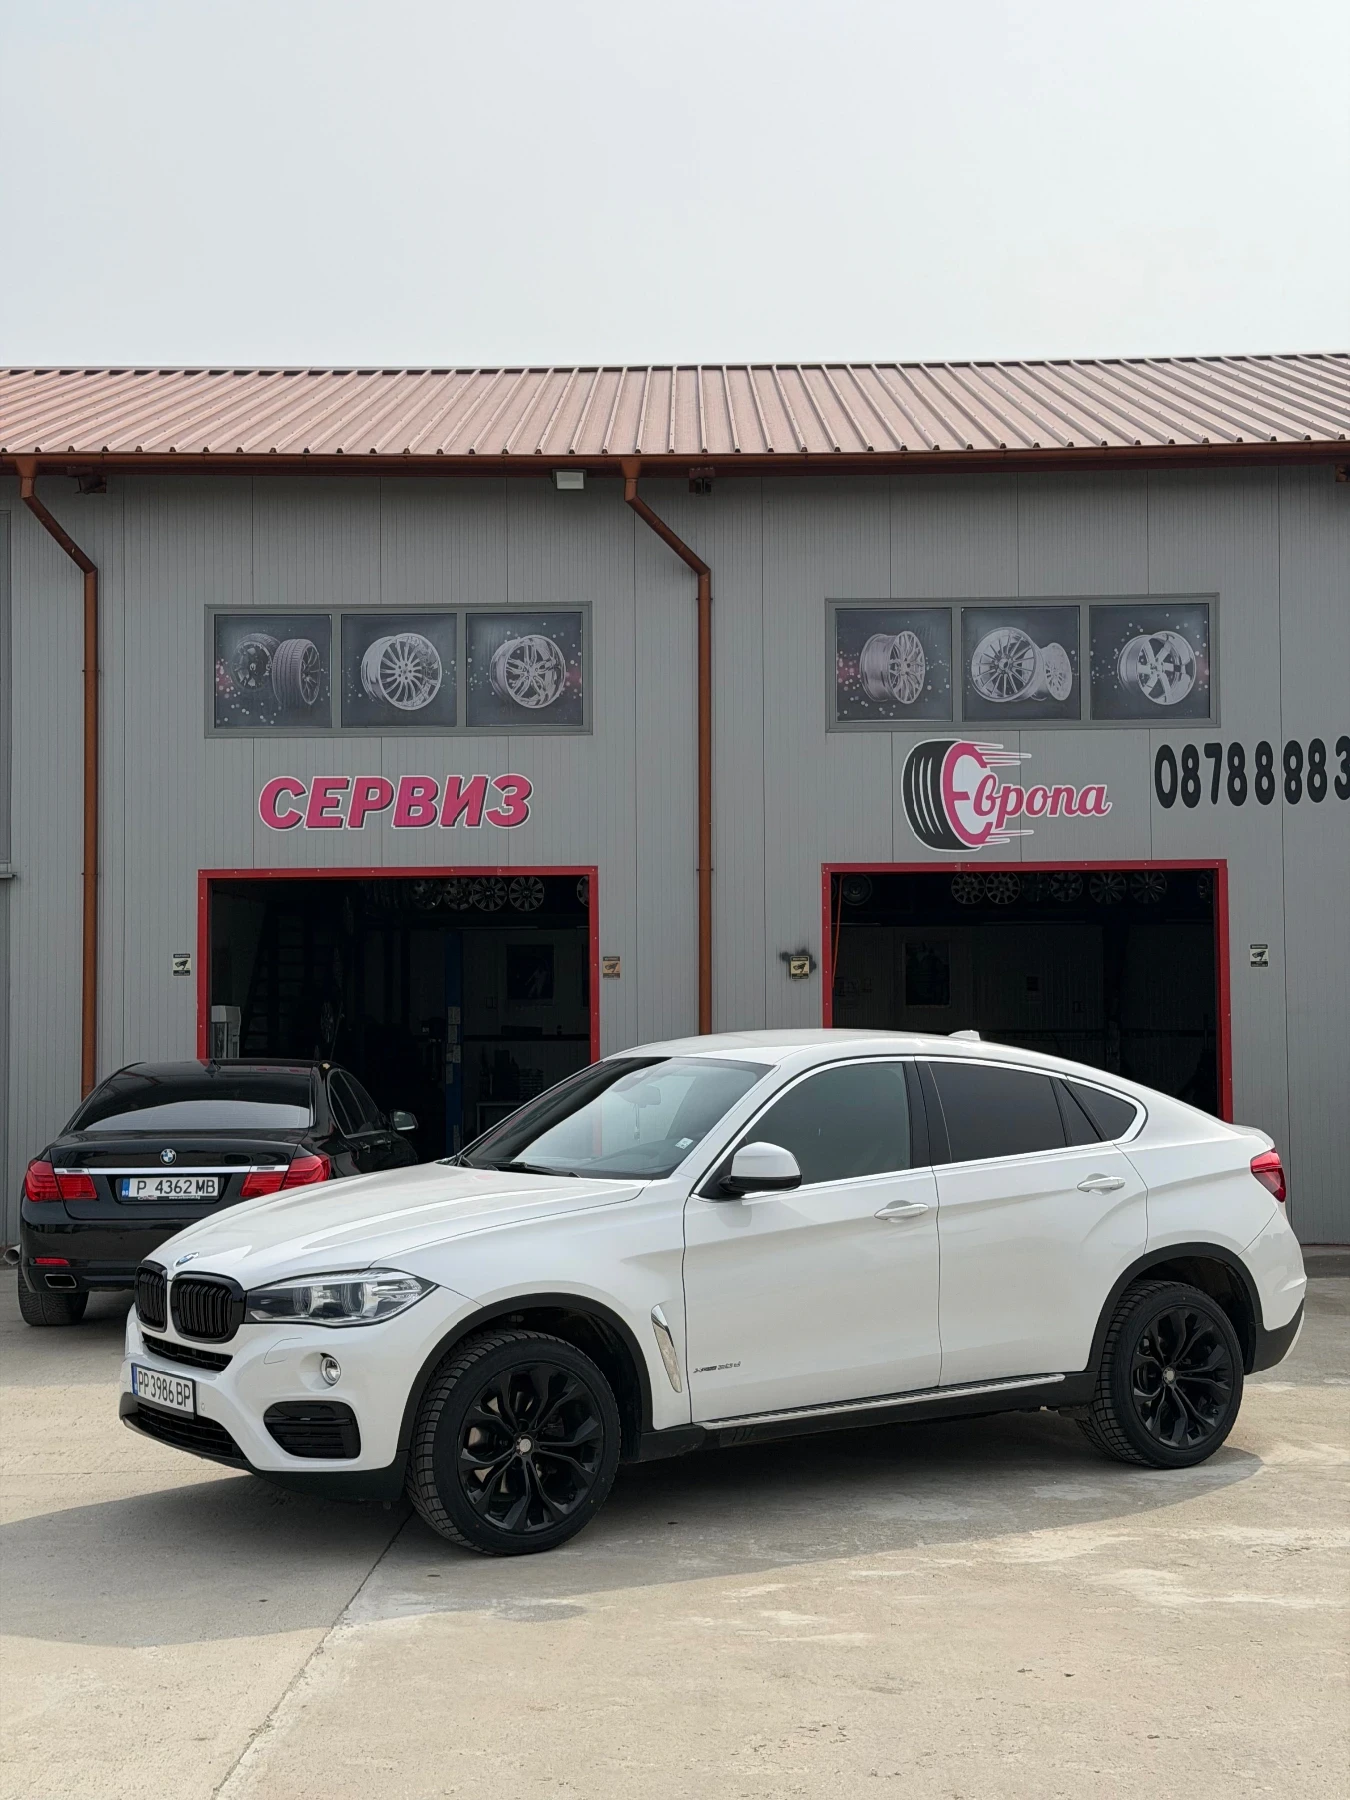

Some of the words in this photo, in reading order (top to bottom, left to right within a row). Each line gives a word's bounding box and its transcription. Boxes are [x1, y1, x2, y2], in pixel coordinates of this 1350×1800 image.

[258, 774, 533, 831] СЕРВИЗ
[941, 740, 1113, 847] Европа
[1154, 735, 1350, 809] 08788883
[155, 1179, 192, 1195] 4362
